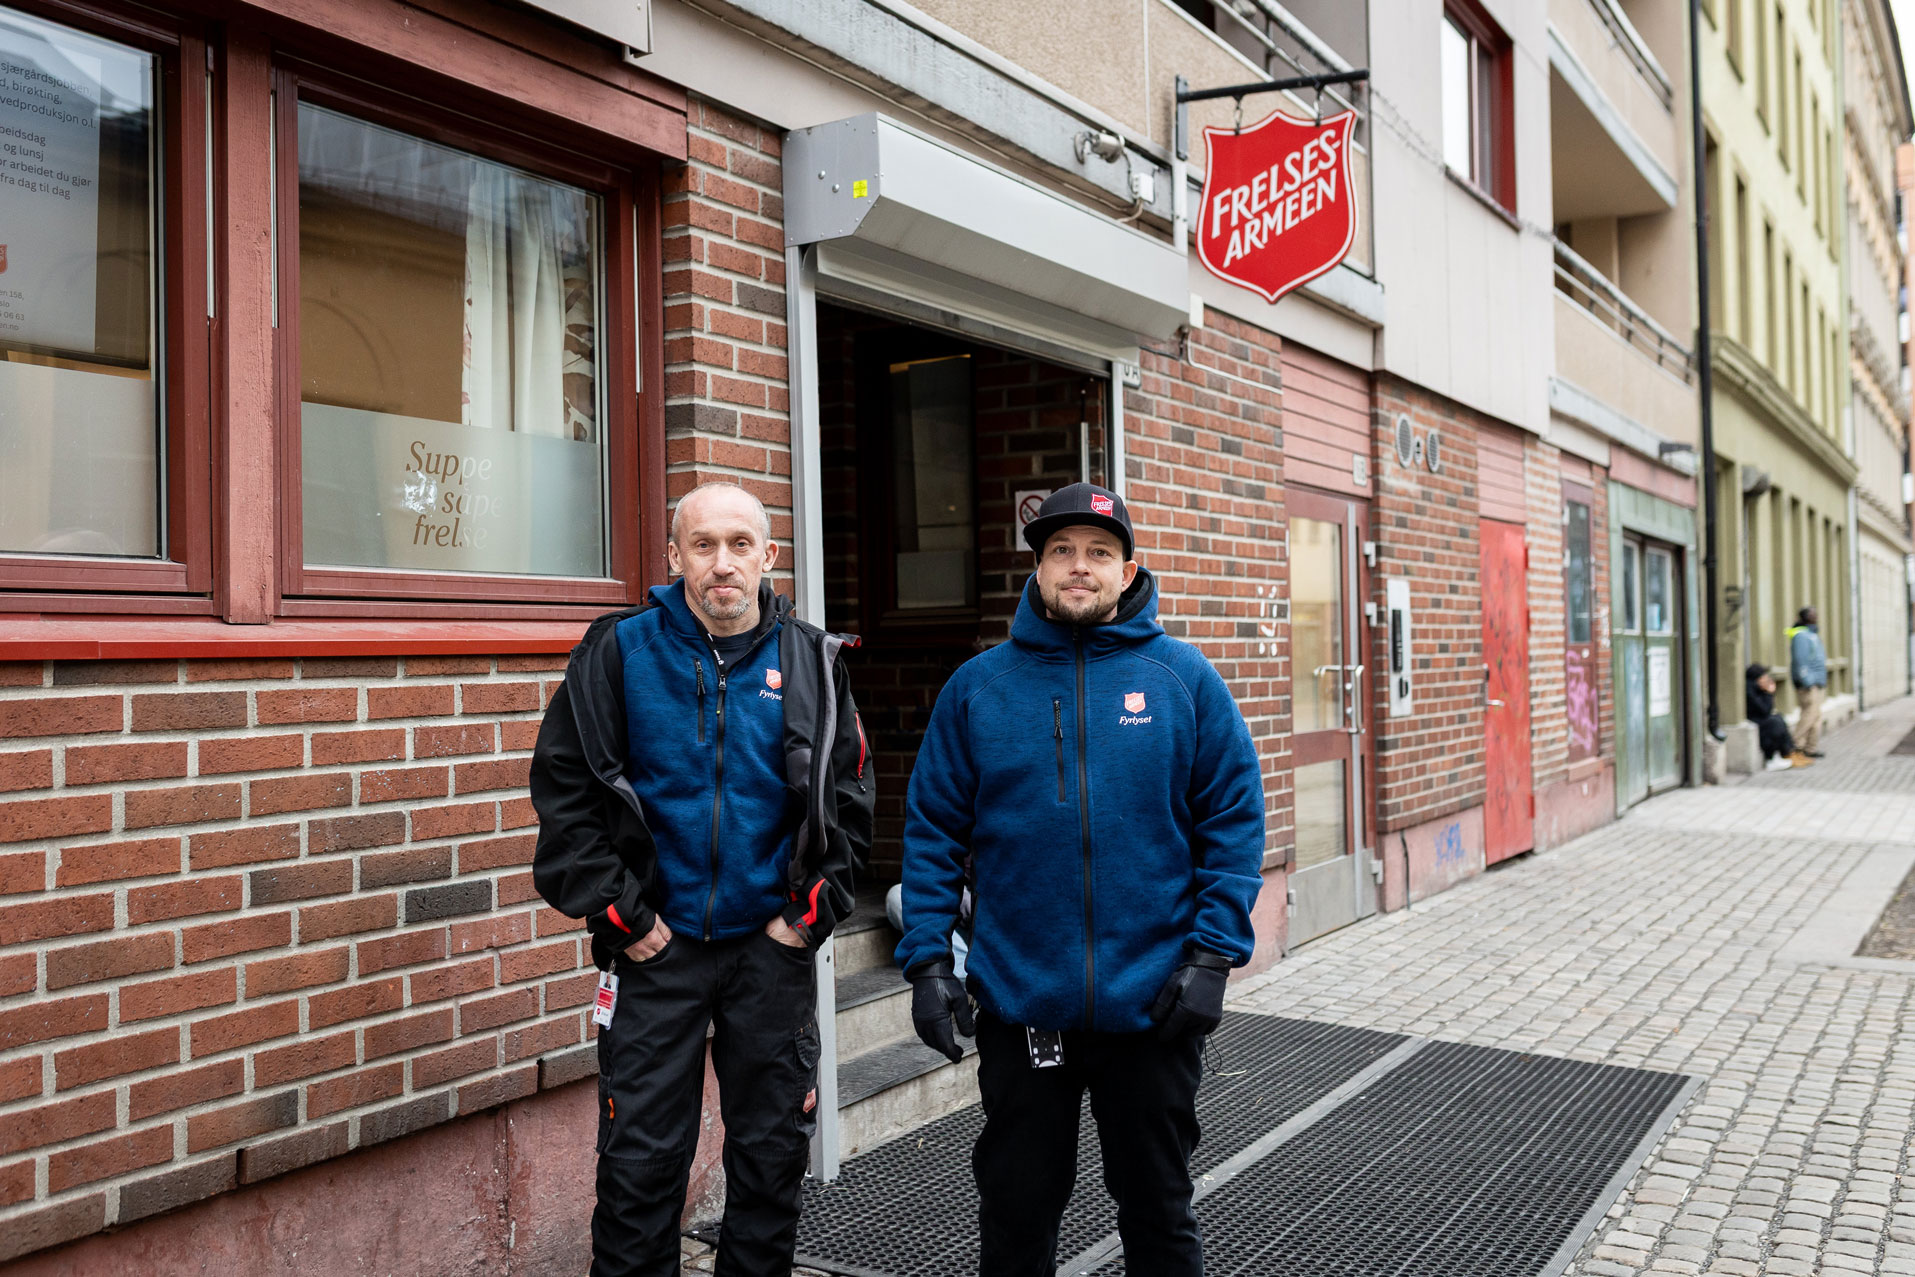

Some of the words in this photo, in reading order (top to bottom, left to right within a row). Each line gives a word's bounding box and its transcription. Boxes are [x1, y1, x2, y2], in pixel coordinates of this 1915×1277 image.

[12, 80, 62, 105] birøkting,
[0, 96, 79, 123] vedproduksjon
[3, 143, 17, 155] og
[19, 145, 44, 162] lunsj
[0, 172, 15, 185] fra
[17, 177, 37, 192] dag
[39, 182, 50, 194] til
[52, 186, 71, 200] dag
[10, 160, 54, 179] arbeidet
[56, 171, 70, 182] du
[71, 175, 92, 187] gjør
[1222, 168, 1337, 268] ARMEEN
[405, 440, 492, 485] Suppe
[442, 482, 504, 523] såpe
[413, 514, 488, 549] frelse
[1119, 715, 1152, 725] Fyrlyset
